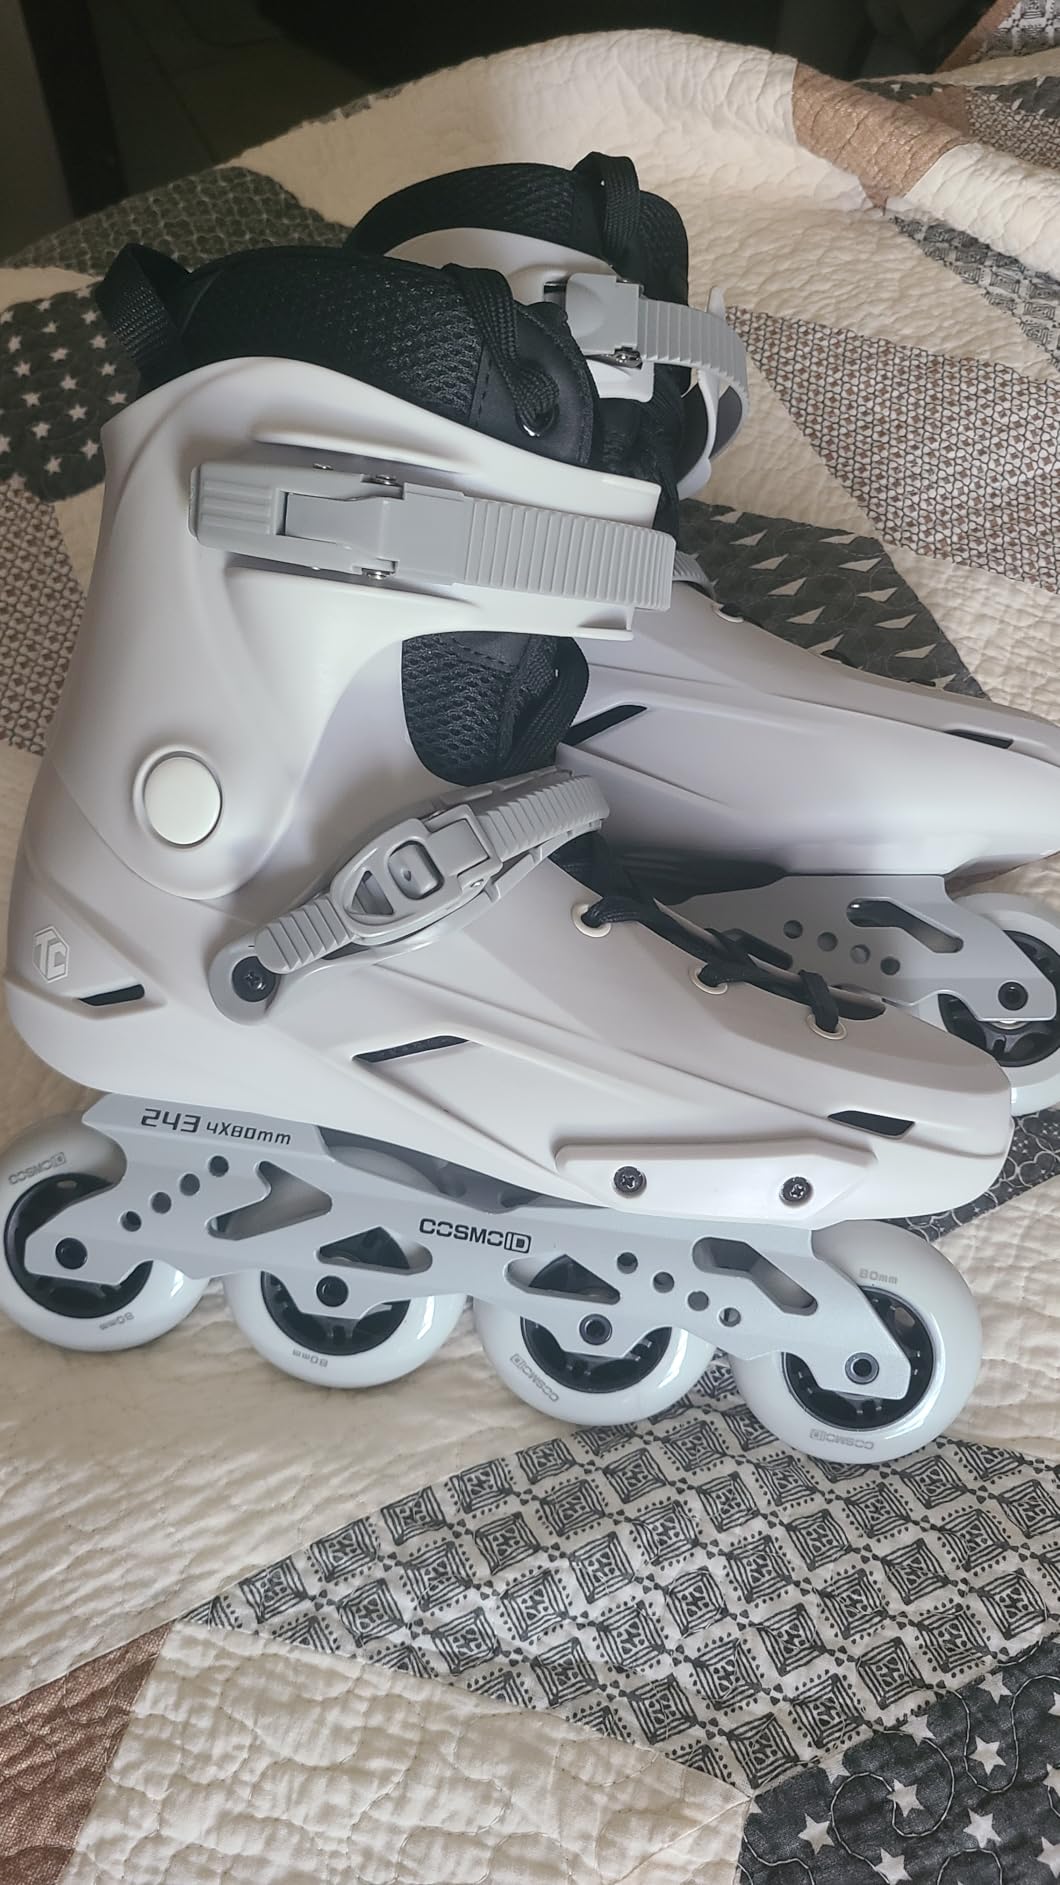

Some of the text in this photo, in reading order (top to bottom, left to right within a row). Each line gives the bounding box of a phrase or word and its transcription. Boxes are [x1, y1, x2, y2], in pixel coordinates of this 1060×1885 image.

[140, 1108, 202, 1133] 243
[419, 1218, 532, 1254] COSMOID
[859, 1268, 898, 1284] 80mm
